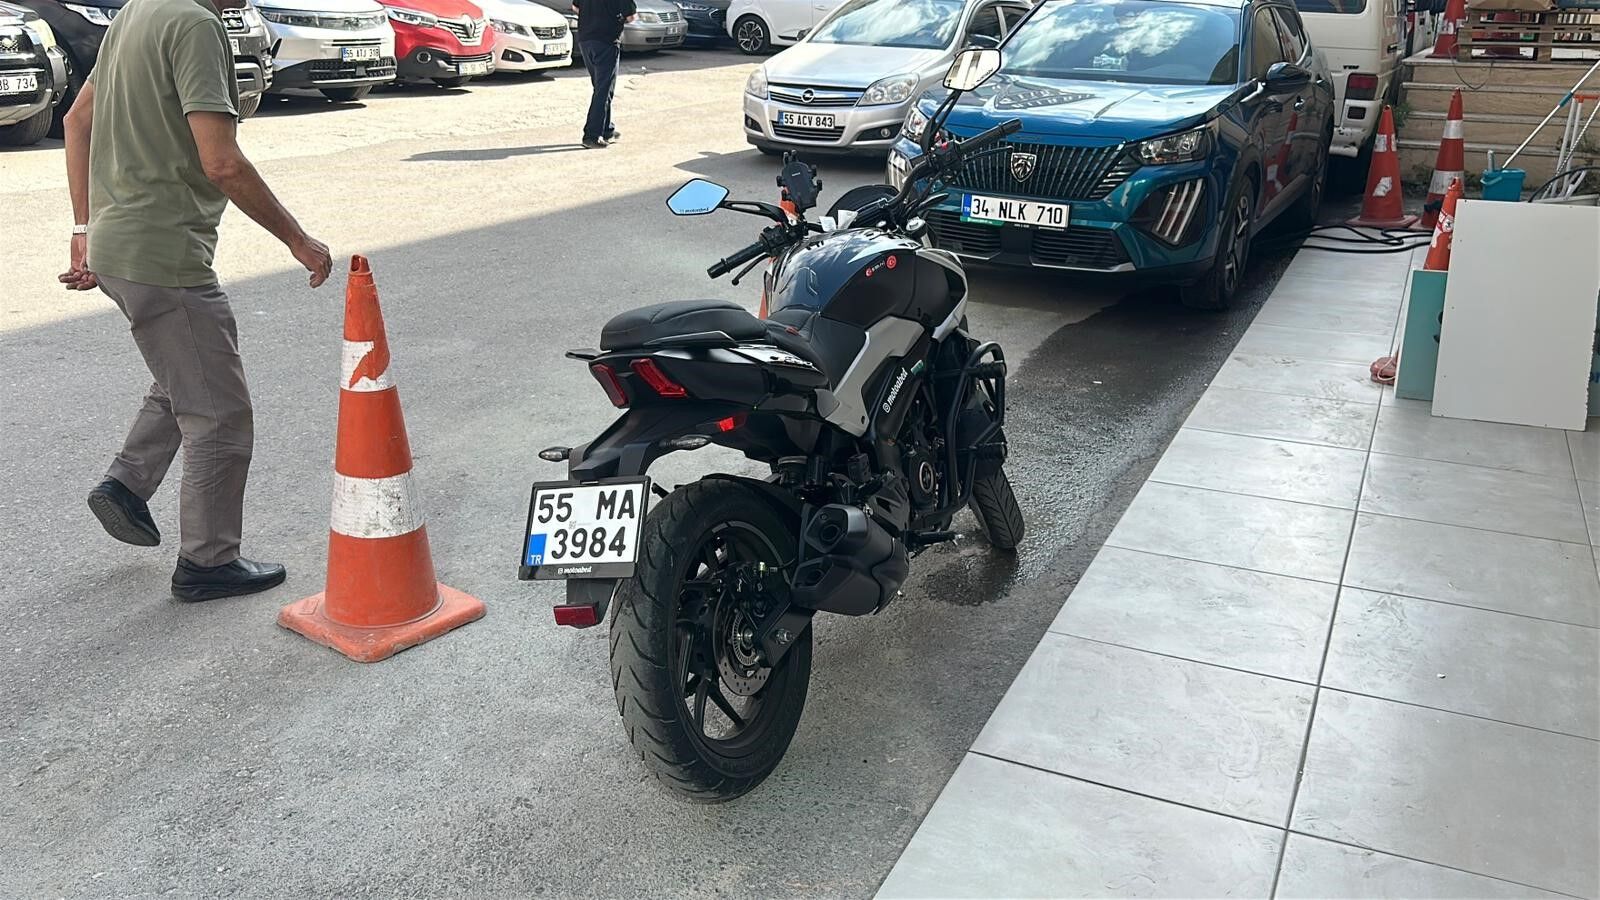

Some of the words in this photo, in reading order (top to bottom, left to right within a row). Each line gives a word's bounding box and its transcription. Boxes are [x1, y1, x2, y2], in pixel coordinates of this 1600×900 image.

[16, 77, 35, 90] 734
[784, 114, 794, 125] 55
[797, 115, 813, 126] ACV
[815, 116, 833, 128] 843
[972, 198, 989, 217] 34
[998, 201, 1027, 221] NLK
[1036, 205, 1063, 225] 710
[887, 367, 908, 406] motoabed
[537, 493, 574, 524] 55
[595, 489, 635, 520] MA
[531, 554, 542, 565] TR
[551, 526, 626, 560] 3984
